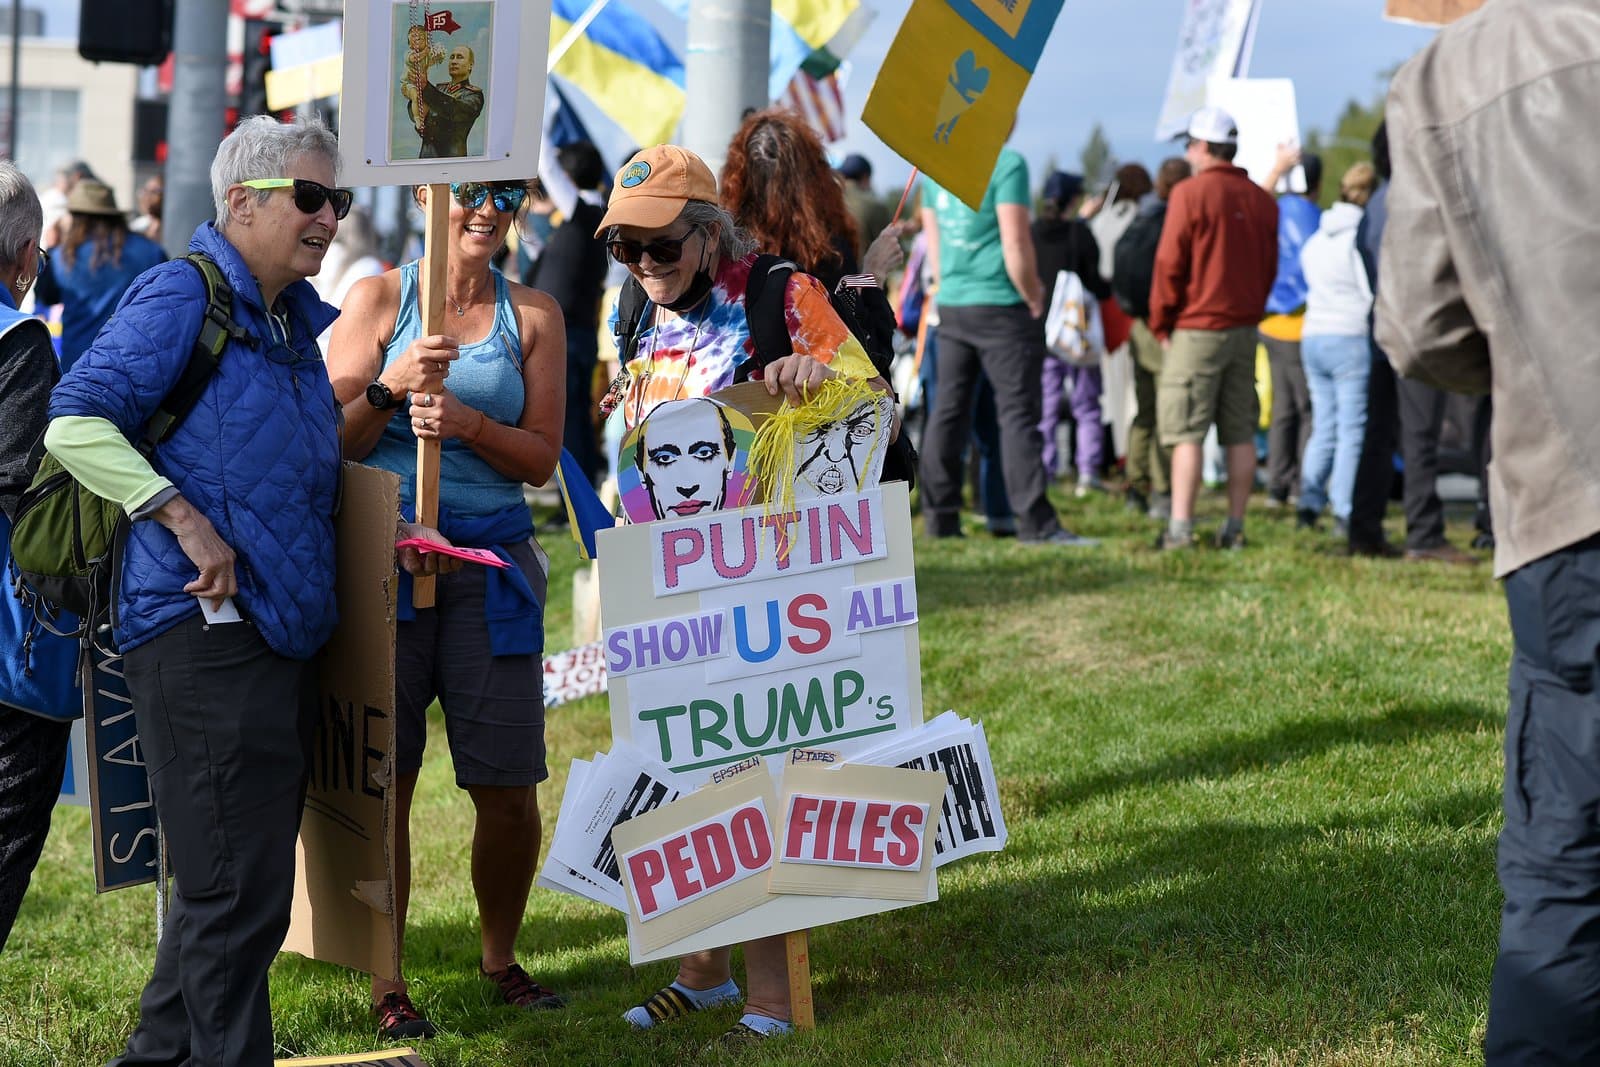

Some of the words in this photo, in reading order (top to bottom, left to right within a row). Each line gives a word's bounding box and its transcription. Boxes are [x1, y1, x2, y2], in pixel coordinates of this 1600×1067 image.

[662, 499, 873, 588] PUTIN
[607, 613, 723, 672] SHOW
[732, 593, 831, 663] US
[846, 584, 914, 631] ALL
[638, 670, 895, 762] TRUMP's
[627, 806, 773, 916] PEDO
[784, 797, 924, 867] FILES
